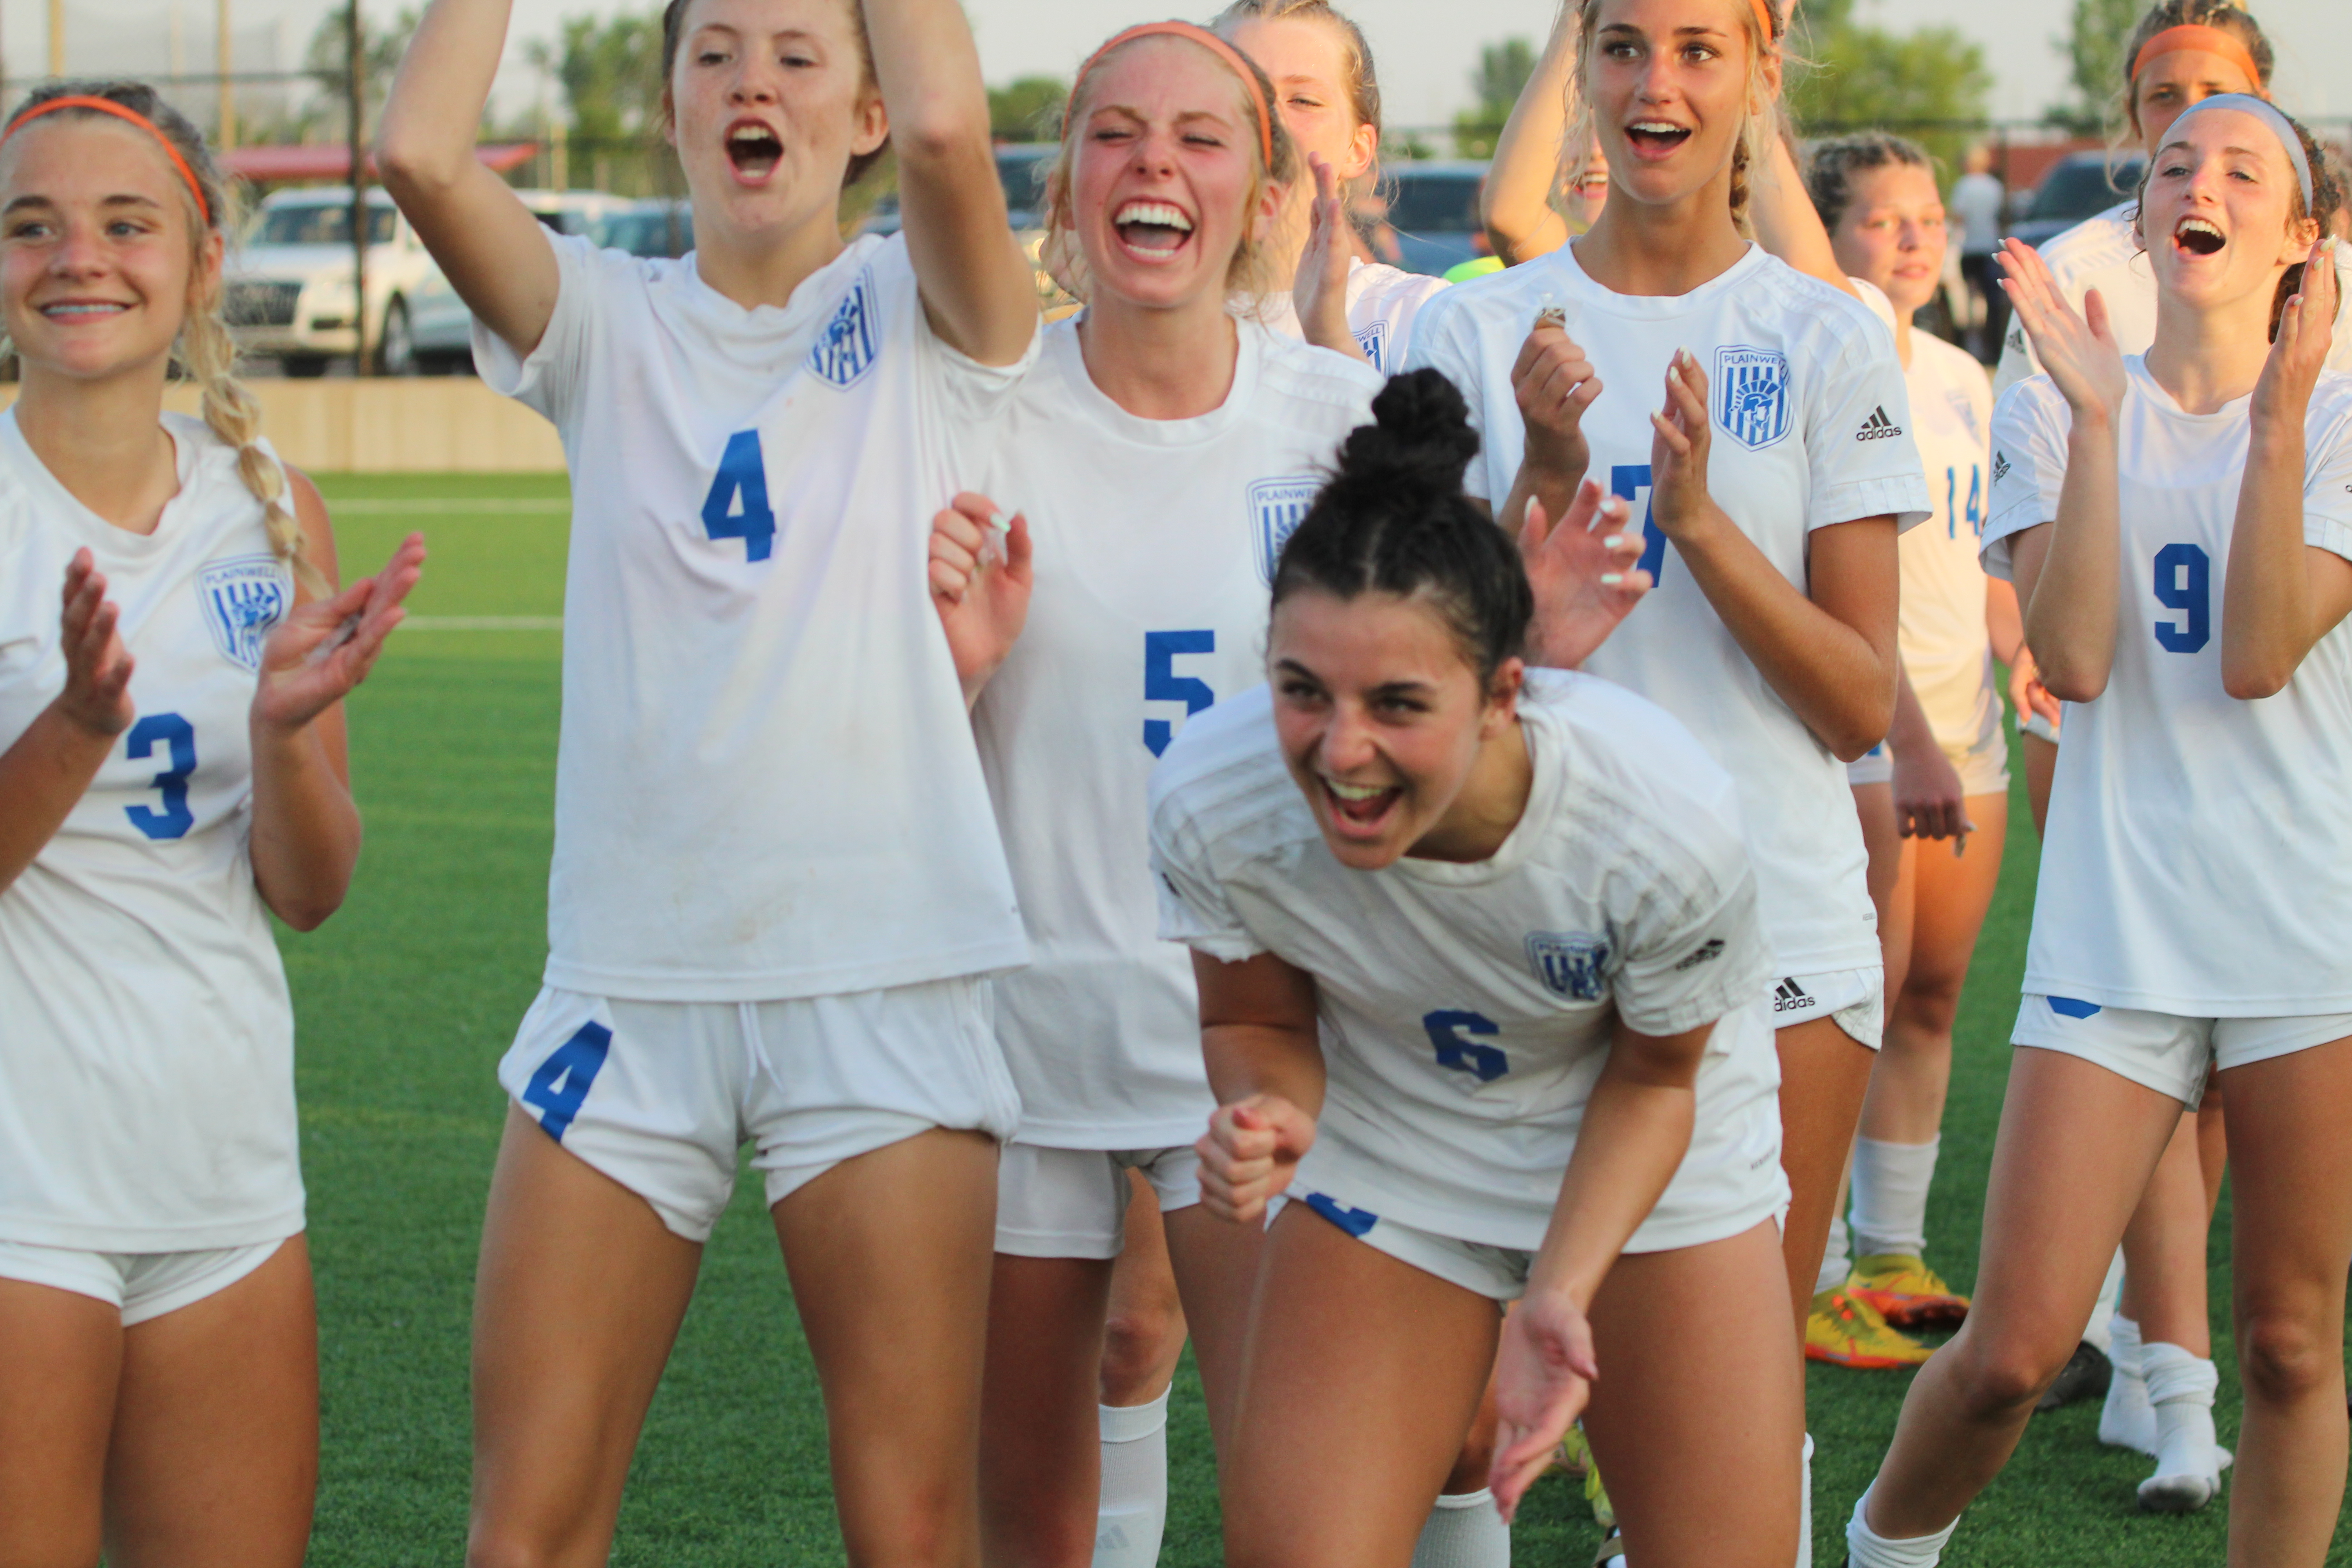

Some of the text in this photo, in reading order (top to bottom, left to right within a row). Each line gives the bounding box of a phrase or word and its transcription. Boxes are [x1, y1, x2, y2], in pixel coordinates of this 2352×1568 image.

[1857, 426, 1901, 441] adidas
[701, 429, 775, 563] 4
[1612, 464, 1668, 588] 7
[1947, 464, 1980, 539] 14
[2154, 543, 2210, 653] 9
[1144, 629, 1215, 758] 5
[124, 712, 196, 840] 3
[1422, 1009, 1509, 1082] 6
[1774, 997, 1815, 1012] didas
[523, 1020, 612, 1142] 4
